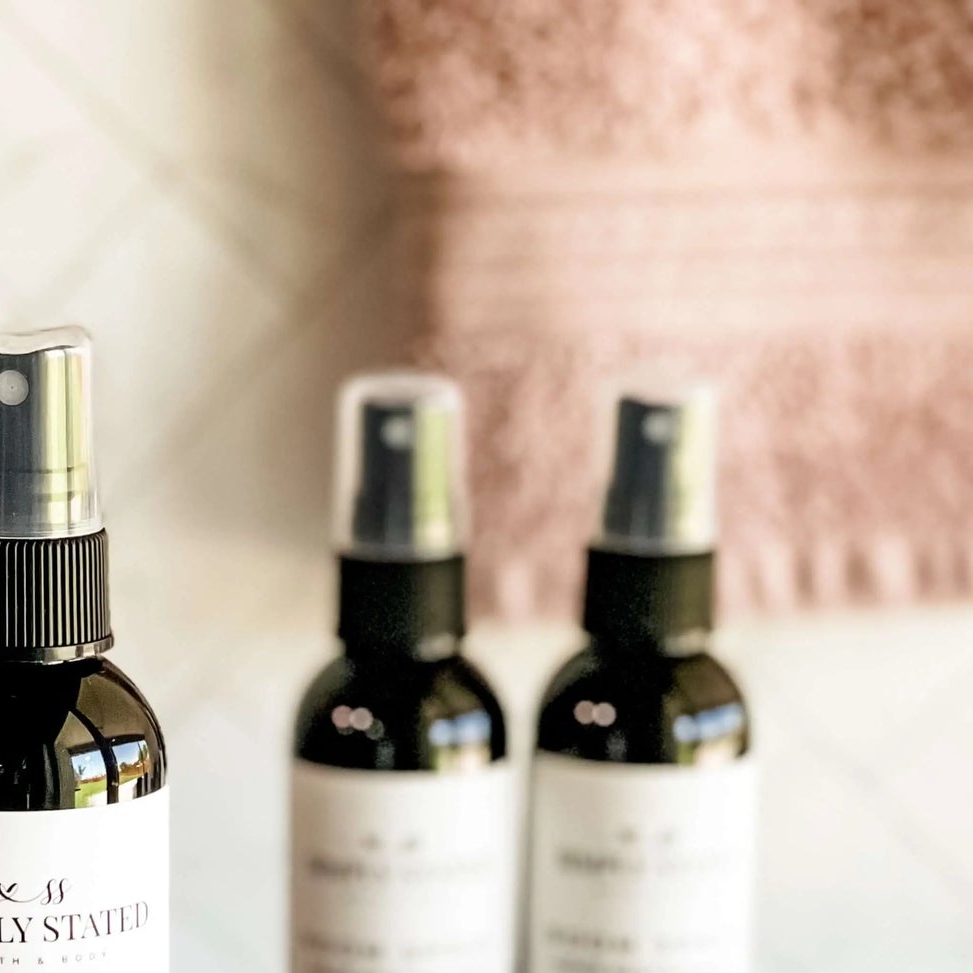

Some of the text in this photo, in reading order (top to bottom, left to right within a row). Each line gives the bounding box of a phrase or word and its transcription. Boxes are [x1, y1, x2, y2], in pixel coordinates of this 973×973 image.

[43, 901, 149, 943] STATED
[37, 957, 44, 965] &
[61, 951, 108, 964] BODY
